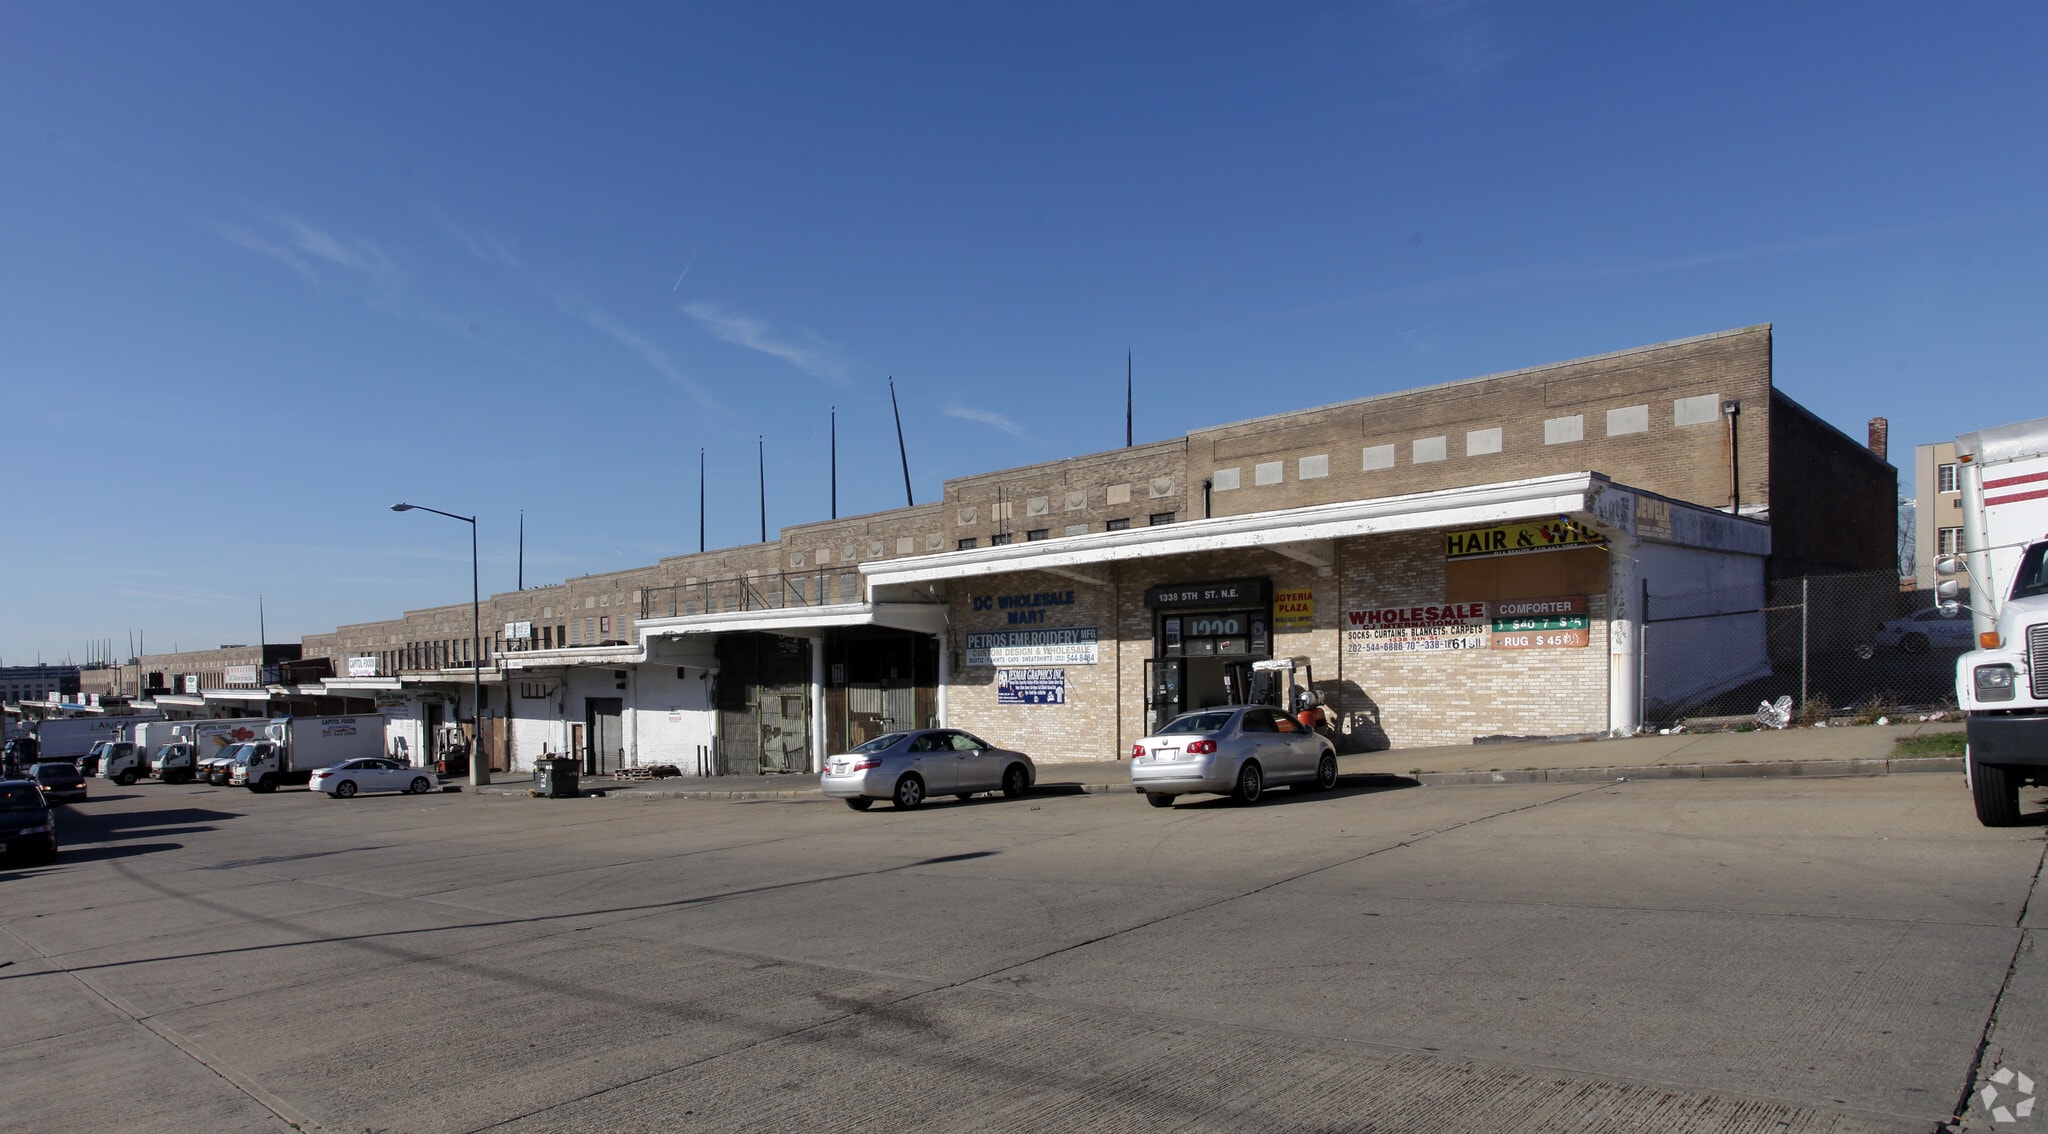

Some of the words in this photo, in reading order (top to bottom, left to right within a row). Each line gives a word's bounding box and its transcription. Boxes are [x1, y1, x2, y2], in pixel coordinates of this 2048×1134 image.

[1447, 530, 1507, 554] HAIR
[1516, 528, 1536, 547] &
[973, 596, 993, 611] DC
[998, 590, 1075, 609] WHOLESALE
[1159, 592, 1178, 602] 1338
[1181, 591, 1198, 600] 5TH
[1204, 590, 1218, 599] ST.
[1221, 589, 1239, 598] N.E.
[1274, 592, 1313, 602] JOYERIA
[1279, 603, 1308, 612] PLAZA
[1500, 602, 1572, 614] COMFORTER
[1008, 609, 1046, 624] MART
[1348, 603, 1484, 625] WHOLESALE
[1380, 619, 1467, 630] INTERNATIONAL
[1450, 625, 1483, 635] CARPETS
[967, 633, 1007, 649] PETROS
[1008, 629, 1079, 647] EMBROIDERY
[1080, 629, 1097, 639] MFG
[1504, 636, 1529, 646] RUG
[972, 649, 1003, 657] CUSTOM
[1005, 648, 1033, 656] DESIGN
[1043, 645, 1091, 655] WHOLESALE
